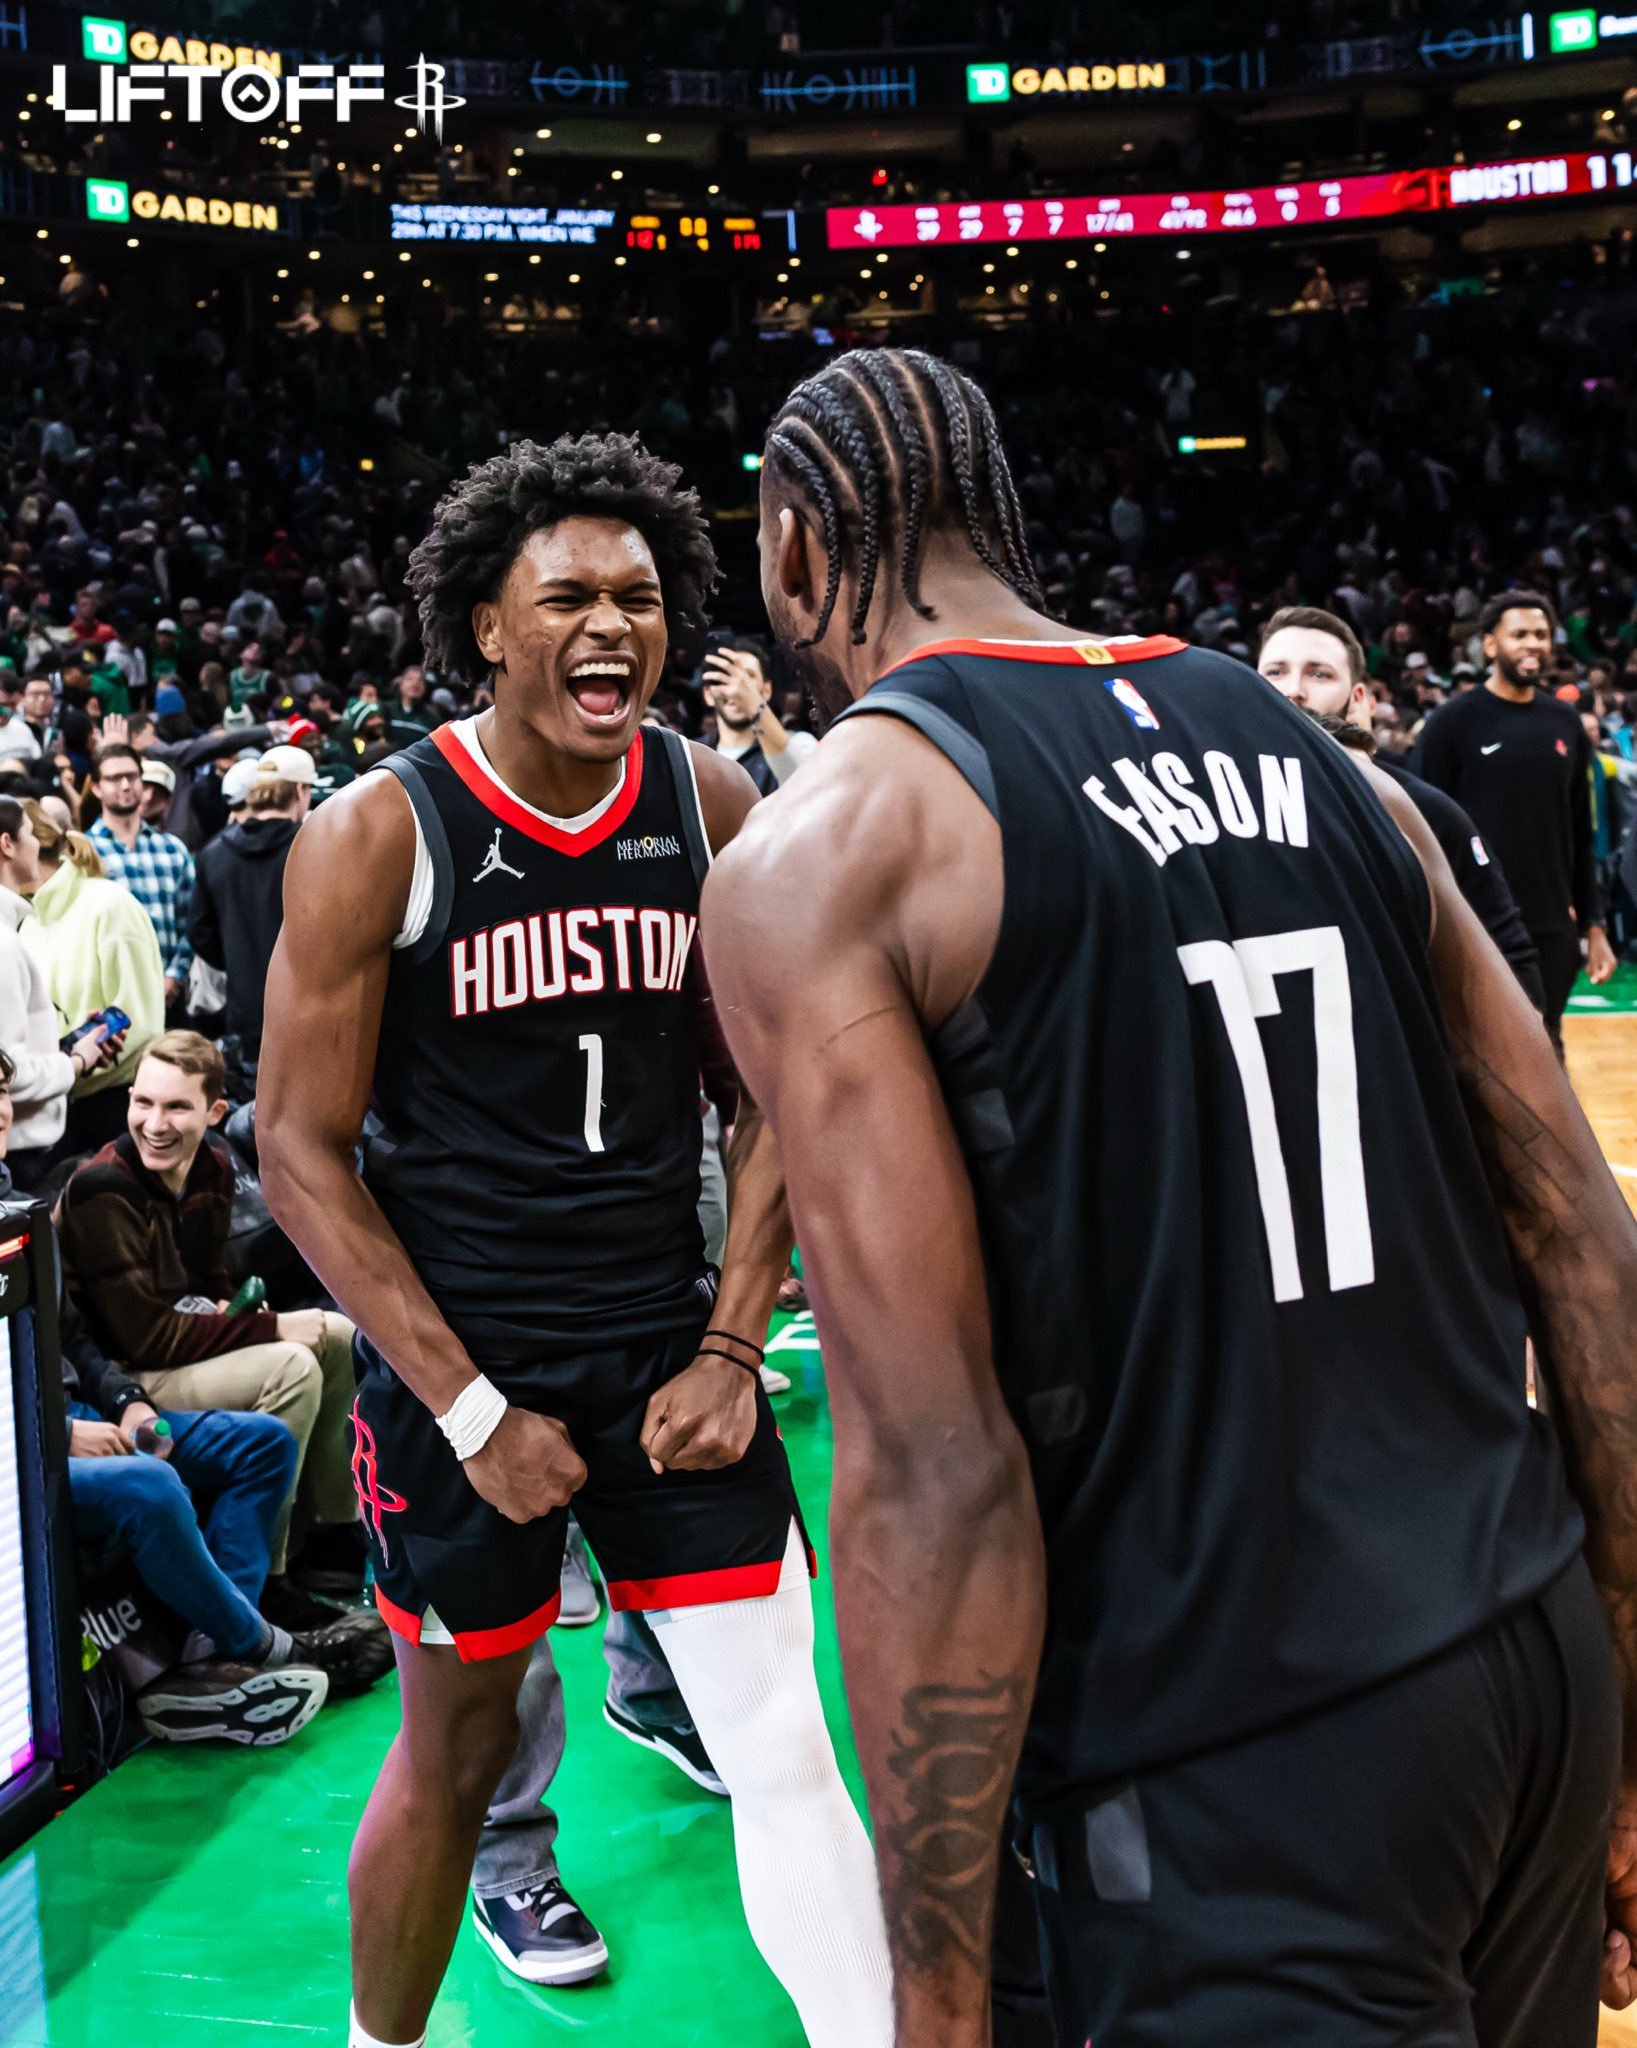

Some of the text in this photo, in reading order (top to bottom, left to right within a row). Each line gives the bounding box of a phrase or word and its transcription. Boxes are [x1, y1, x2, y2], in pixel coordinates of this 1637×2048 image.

[130, 31, 283, 79] GARDEN
[1012, 63, 1166, 94] GARDEN
[1450, 158, 1568, 203] HOUSTON
[132, 190, 278, 231] GARDEN
[1082, 750, 1309, 868] EASON
[617, 835, 680, 851] MEMORIAL
[617, 844, 681, 860] HERMANN
[450, 905, 697, 1018] HOUSTON
[578, 1034, 605, 1152] 1
[1177, 926, 1375, 1303] 17
